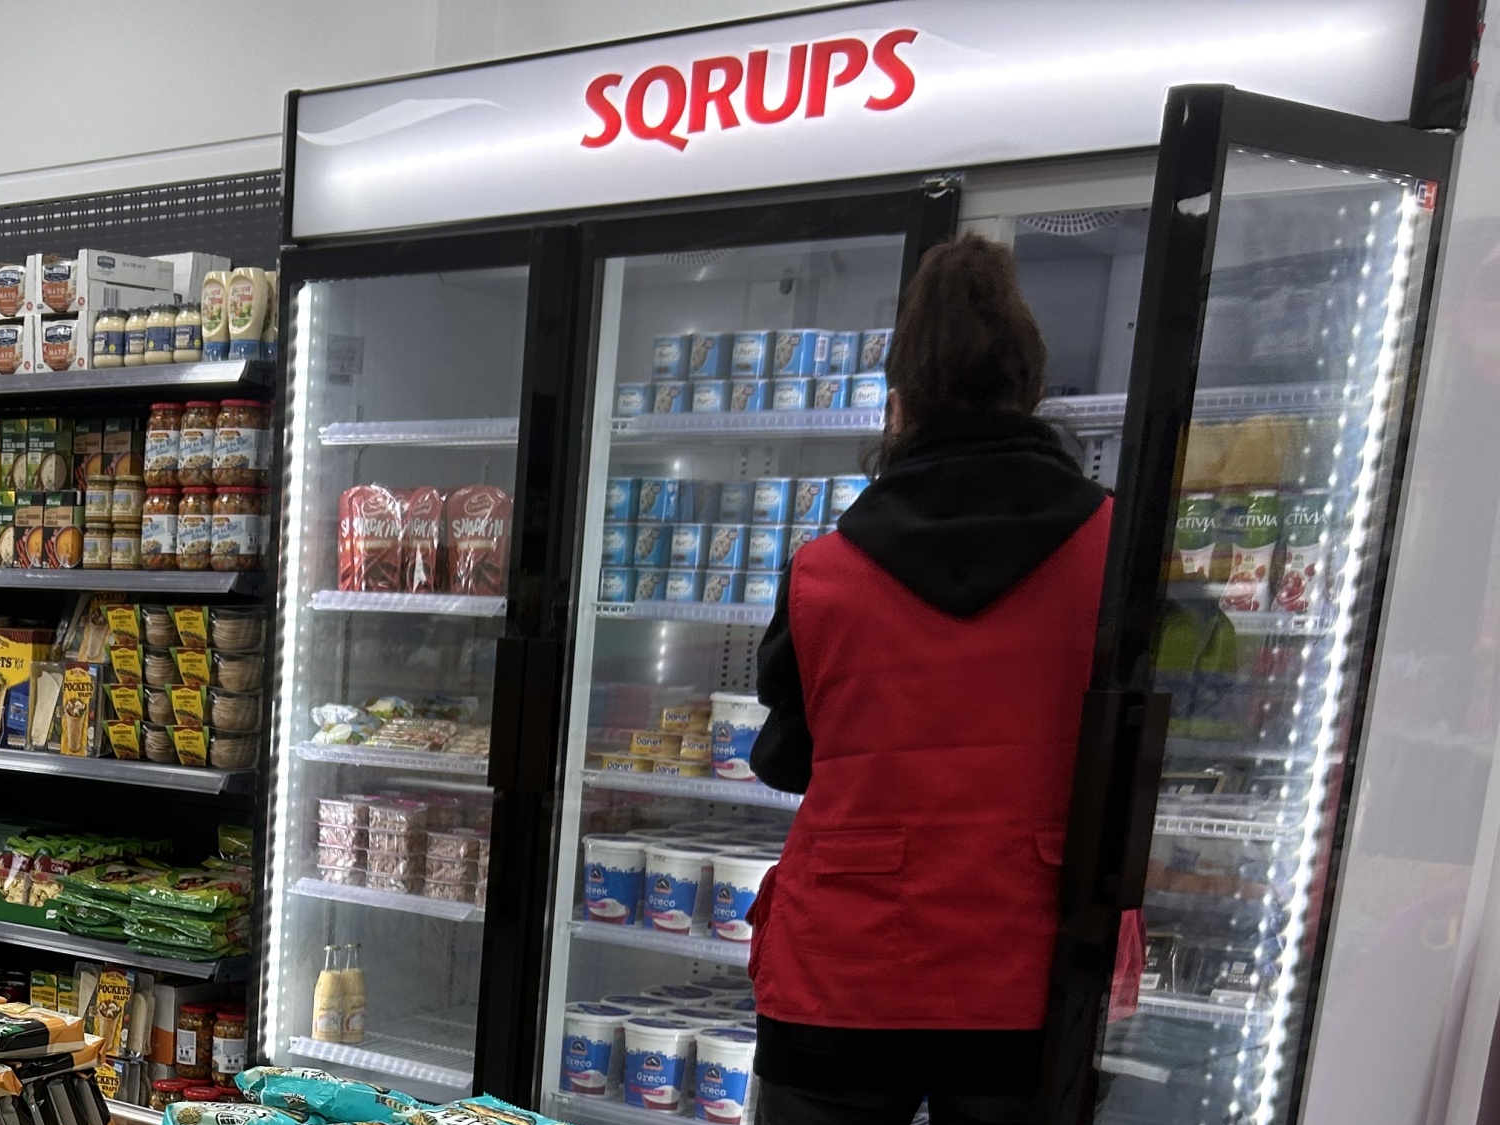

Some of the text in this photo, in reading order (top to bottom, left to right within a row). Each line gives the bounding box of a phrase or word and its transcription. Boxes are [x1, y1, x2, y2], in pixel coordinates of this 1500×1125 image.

[582, 30, 916, 149] SQRUPS
[1177, 512, 1216, 530] CTIVIA
[63, 681, 94, 692] POCKETS
[665, 711, 691, 722] Danet
[636, 736, 663, 747] Danet
[683, 741, 709, 751] Danet
[607, 760, 634, 772] Danet
[655, 764, 680, 776] Danet
[648, 895, 676, 908] Greco
[97, 984, 132, 996] POCKETS
[564, 1056, 592, 1069] Greco
[95, 1075, 120, 1086] CKETS
[636, 1072, 667, 1084] Greco
[699, 1084, 727, 1098] Greco
